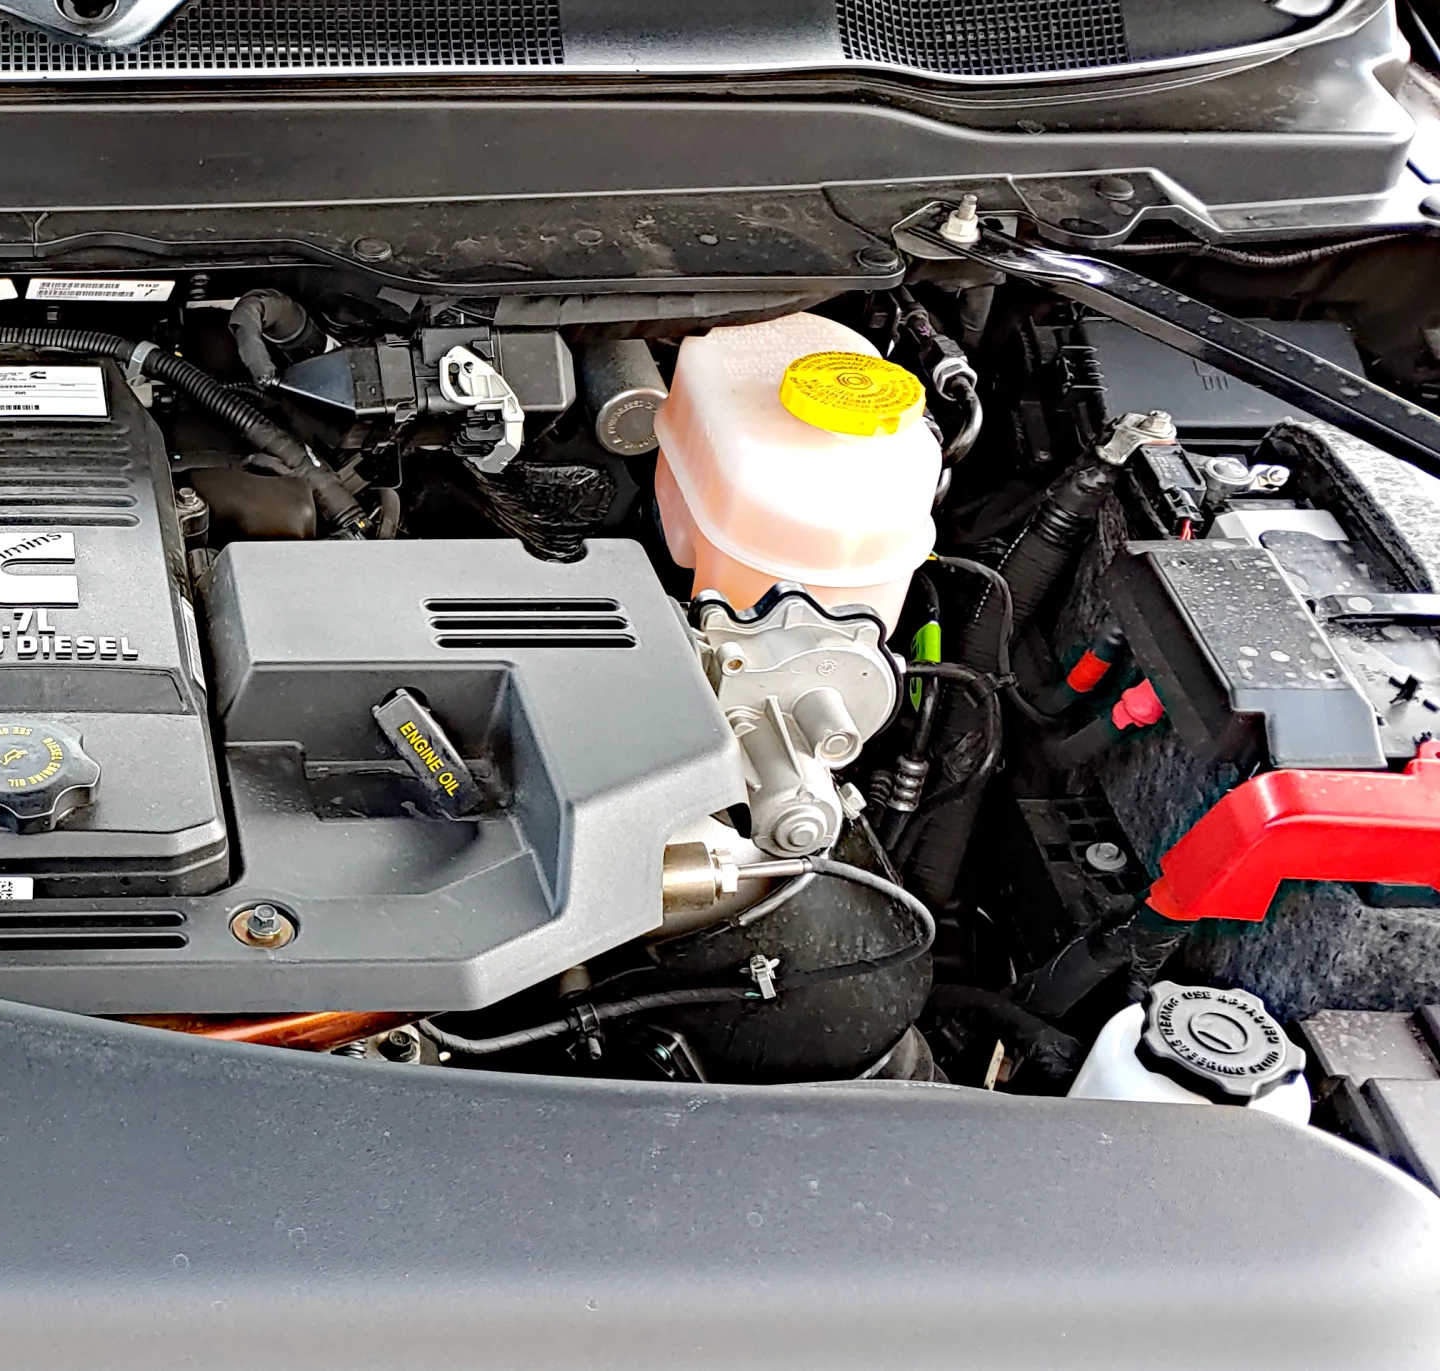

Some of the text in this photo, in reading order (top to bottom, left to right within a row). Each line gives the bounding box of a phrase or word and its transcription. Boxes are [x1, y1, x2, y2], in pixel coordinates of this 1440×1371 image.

[17, 636, 138, 661] DIESEL
[12, 727, 32, 736] SEE
[398, 721, 460, 797] ENGINE OIL
[8, 778, 28, 787] OIL
[1181, 991, 1213, 1000] USE
